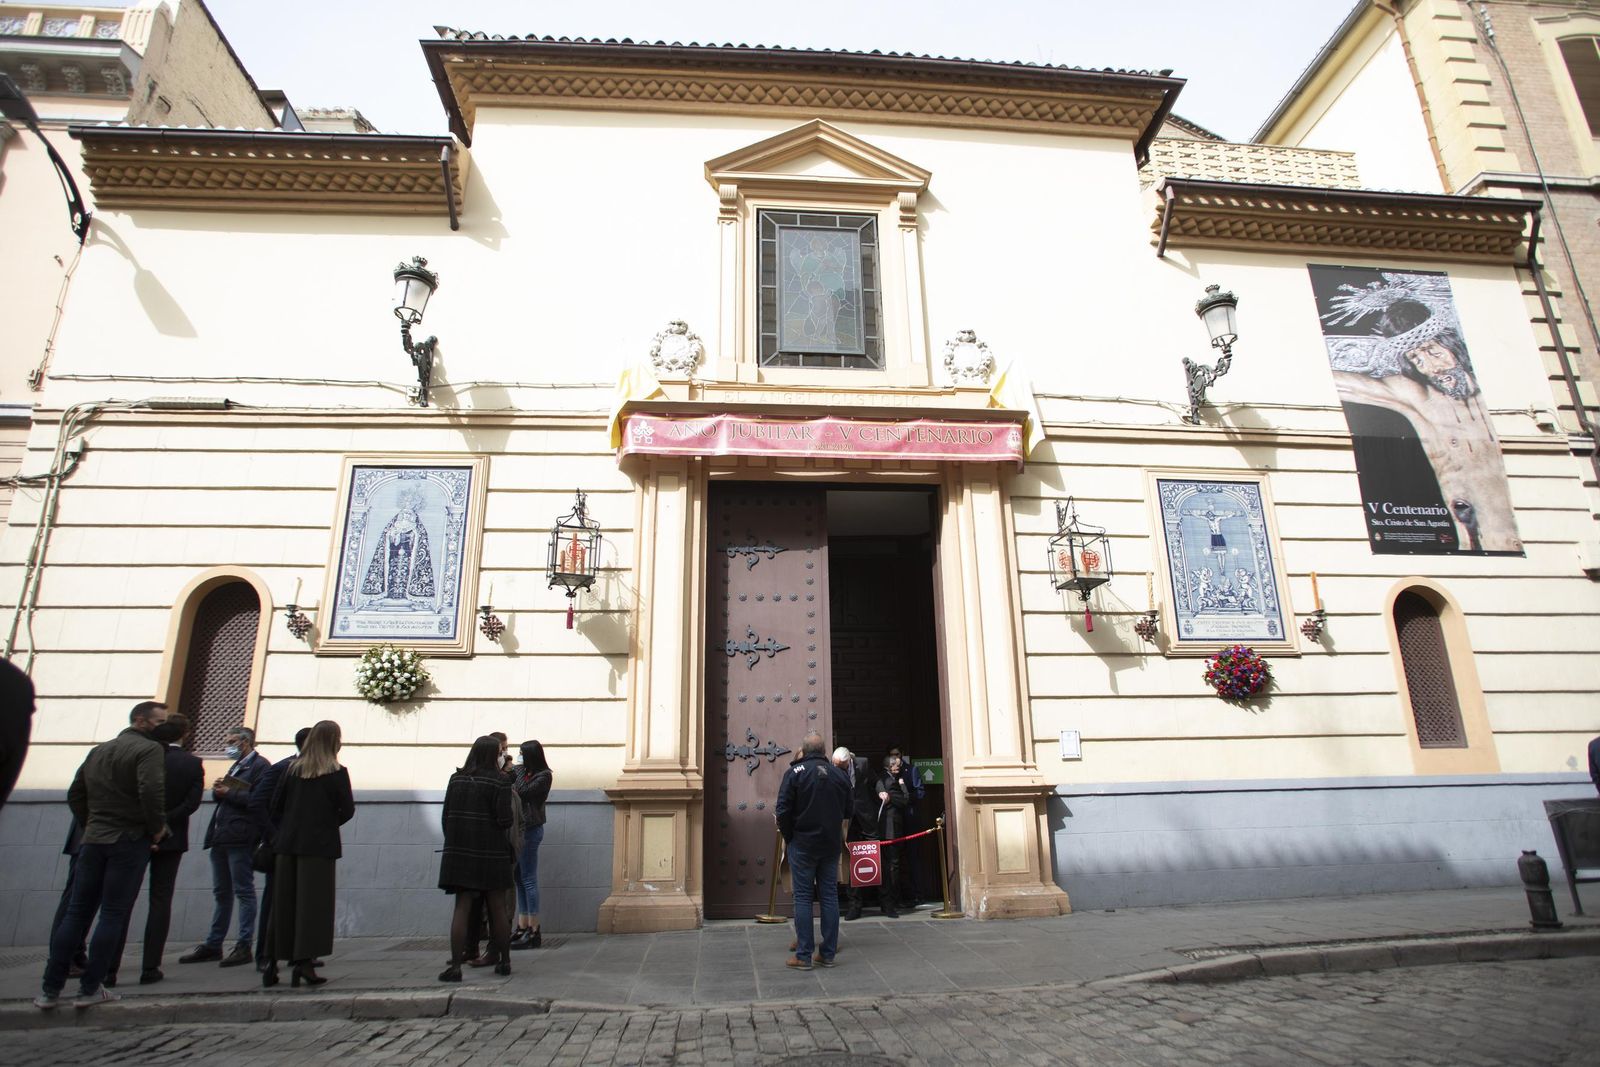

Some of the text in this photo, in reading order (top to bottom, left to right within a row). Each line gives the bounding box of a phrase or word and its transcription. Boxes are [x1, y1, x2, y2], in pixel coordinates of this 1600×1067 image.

[731, 423, 816, 439] JUBILAR
[839, 426, 853, 440] V
[859, 427, 994, 444] CENTENARIO
[1368, 502, 1448, 515] V Centenario
[1385, 518, 1404, 526] Cristo
